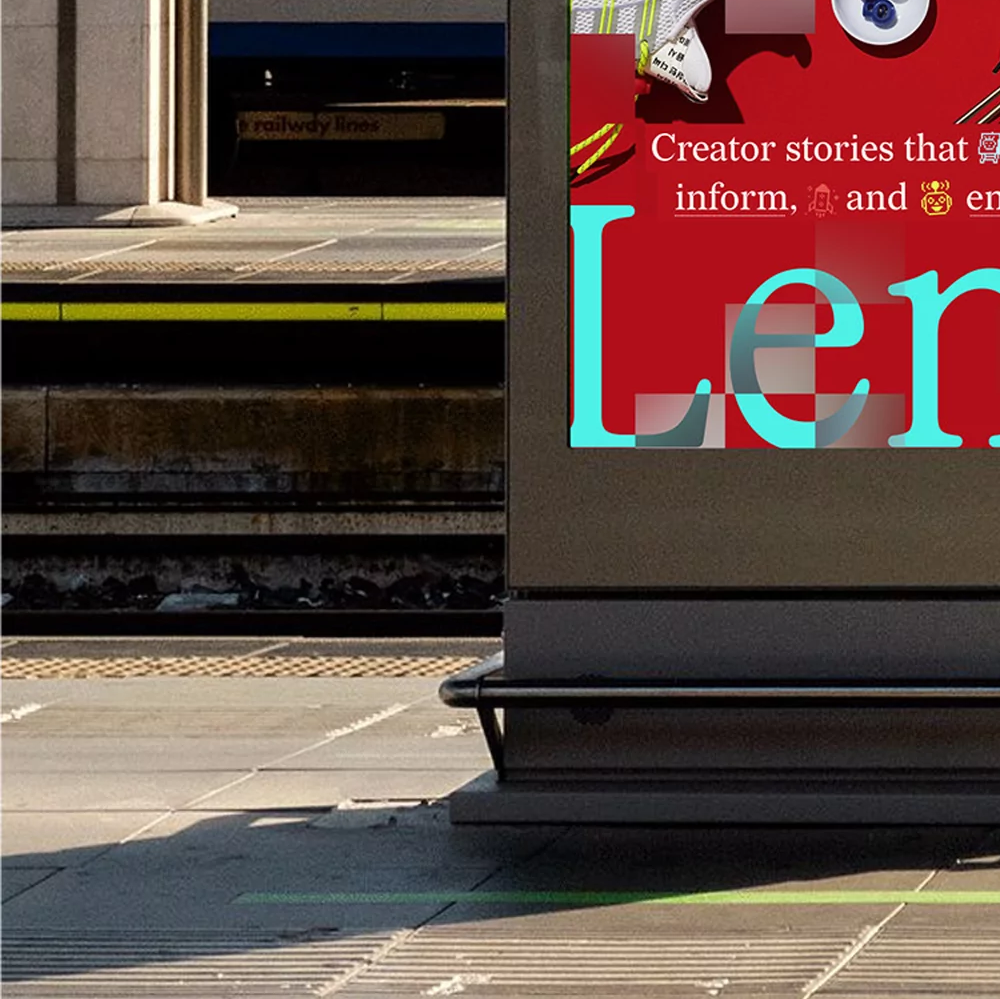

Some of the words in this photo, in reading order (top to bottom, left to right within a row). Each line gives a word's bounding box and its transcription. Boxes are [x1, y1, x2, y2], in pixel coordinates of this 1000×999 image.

[253, 115, 330, 135] railway
[335, 115, 381, 133] lines
[651, 132, 776, 163] Creator
[785, 132, 895, 163] stories
[904, 132, 969, 163] that
[675, 182, 798, 215] inform,
[846, 183, 907, 212] and
